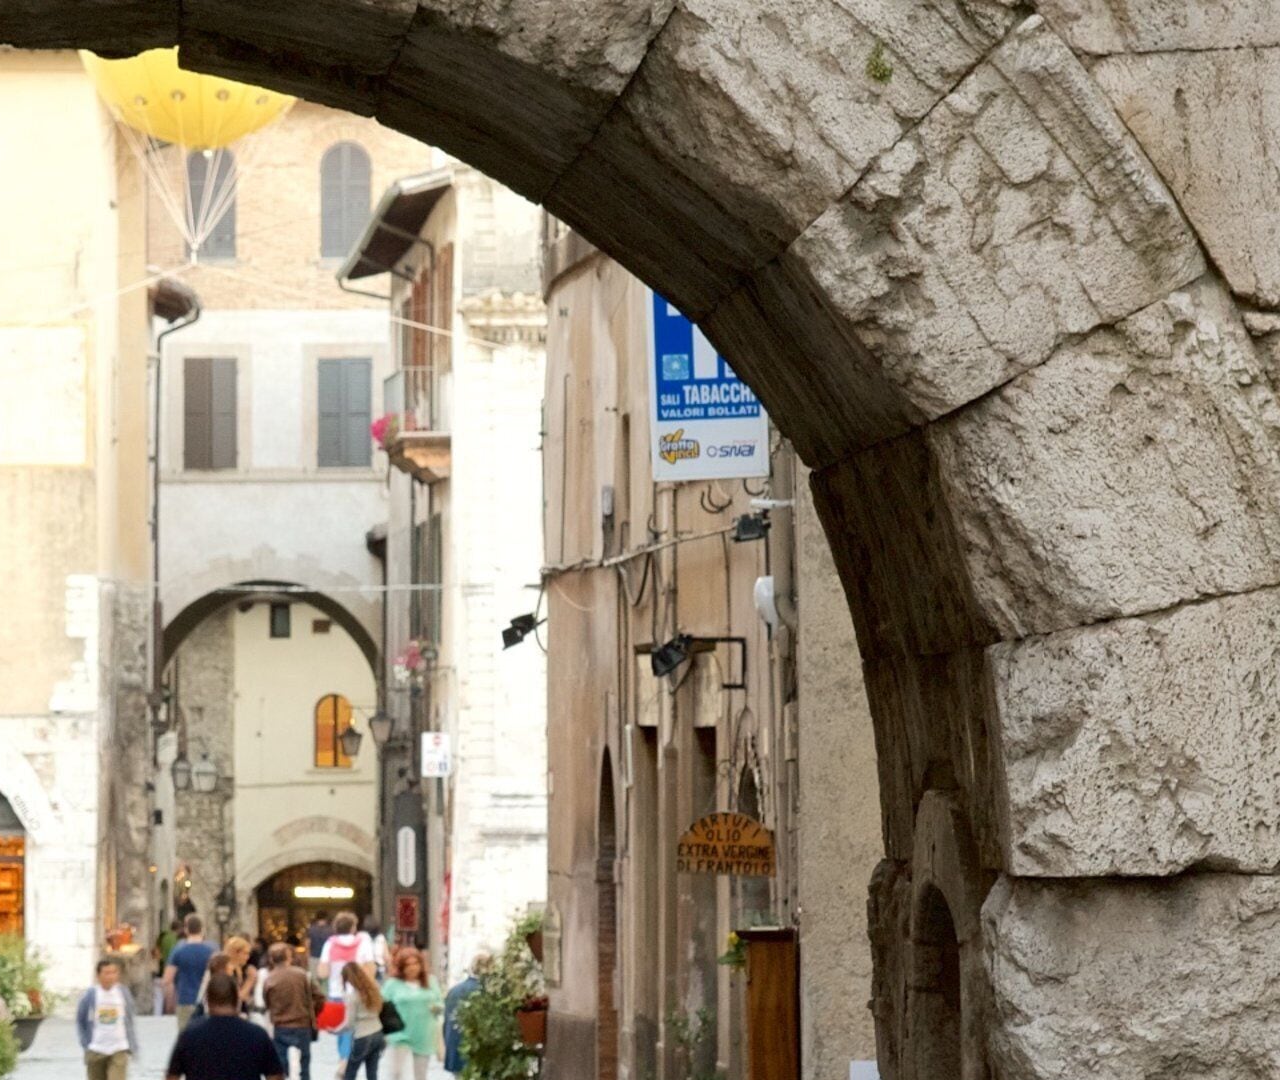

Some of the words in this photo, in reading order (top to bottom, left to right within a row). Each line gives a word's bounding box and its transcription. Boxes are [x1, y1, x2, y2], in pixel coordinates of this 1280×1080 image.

[661, 394, 680, 405] SALI
[661, 407, 705, 418] VALORI
[708, 404, 758, 416] BOLLATI
[689, 812, 762, 839] TARTUFI
[706, 829, 741, 842] OLIO
[677, 844, 719, 857] EXTRA
[722, 845, 771, 860] VERGINE
[677, 860, 690, 872] DI
[697, 861, 771, 875] FRANTOIO
